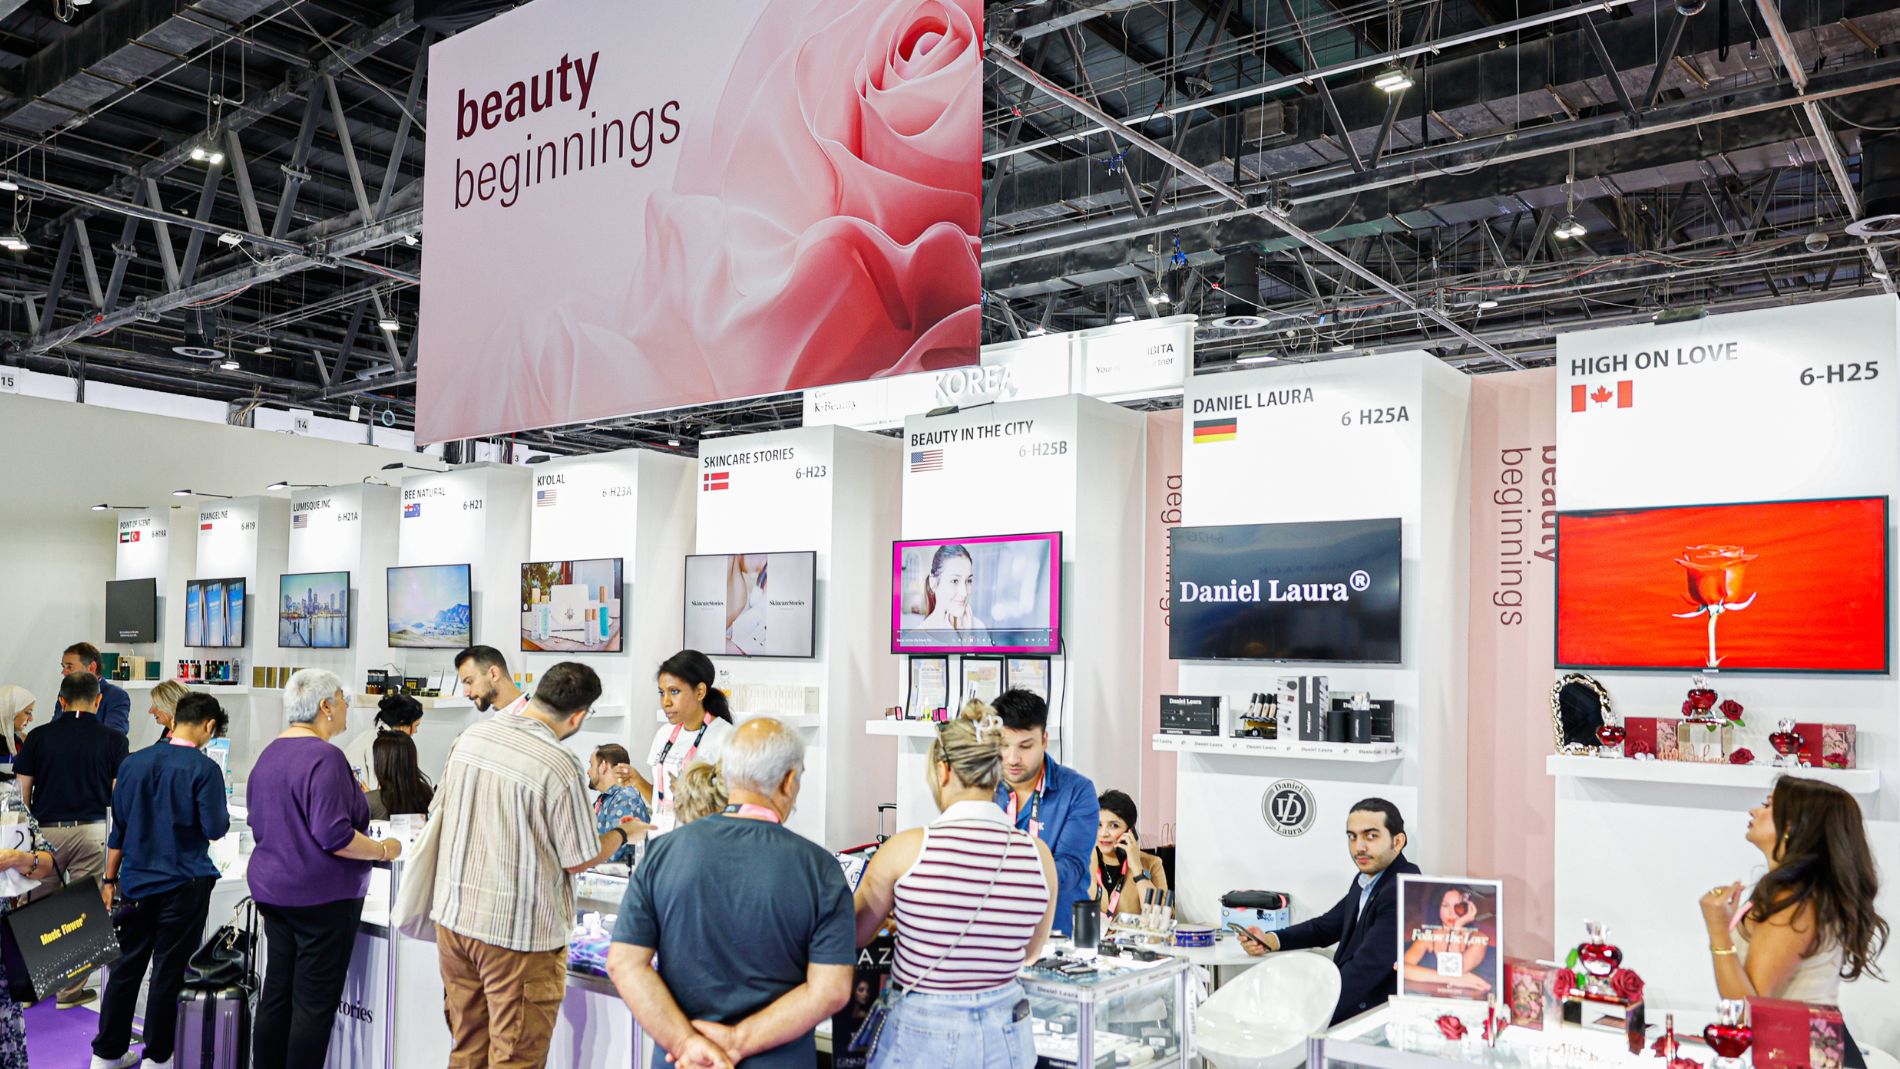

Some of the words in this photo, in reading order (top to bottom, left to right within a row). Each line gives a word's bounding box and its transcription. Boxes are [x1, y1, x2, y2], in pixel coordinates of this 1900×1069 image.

[457, 51, 600, 140] beauty
[455, 100, 681, 209] beginnings
[1571, 354, 1628, 377] HIGH
[1634, 349, 1669, 371] ON
[1676, 342, 1739, 366] LOVE
[1799, 361, 1880, 386] 6-H25
[1, 376, 14, 388] 15
[935, 366, 1018, 404] KOREA
[1193, 394, 1252, 414] DANIEL
[1257, 387, 1314, 408] LAURA
[297, 419, 307, 429] 14
[911, 429, 958, 446] BEAUTY
[961, 427, 974, 441] IN
[977, 424, 1001, 439] THE
[1004, 420, 1034, 436] CITY
[1019, 440, 1068, 457] 6-H25B
[704, 452, 751, 468] SKINCARE
[753, 448, 794, 463] STORIES
[795, 465, 827, 479] 6-H23
[404, 490, 416, 500] BEE
[416, 487, 446, 498] NATURAL
[463, 499, 483, 510] 6-H21
[200, 511, 228, 521] EVANGELINE
[337, 512, 358, 522] 6-H21A
[120, 521, 132, 529] POINT
[241, 521, 256, 530] 6-H19
[1493, 446, 1532, 626] beginnings
[1179, 579, 1261, 603] Daniel
[1275, 782, 1303, 793] Daniel
[1277, 825, 1302, 835] Laura
